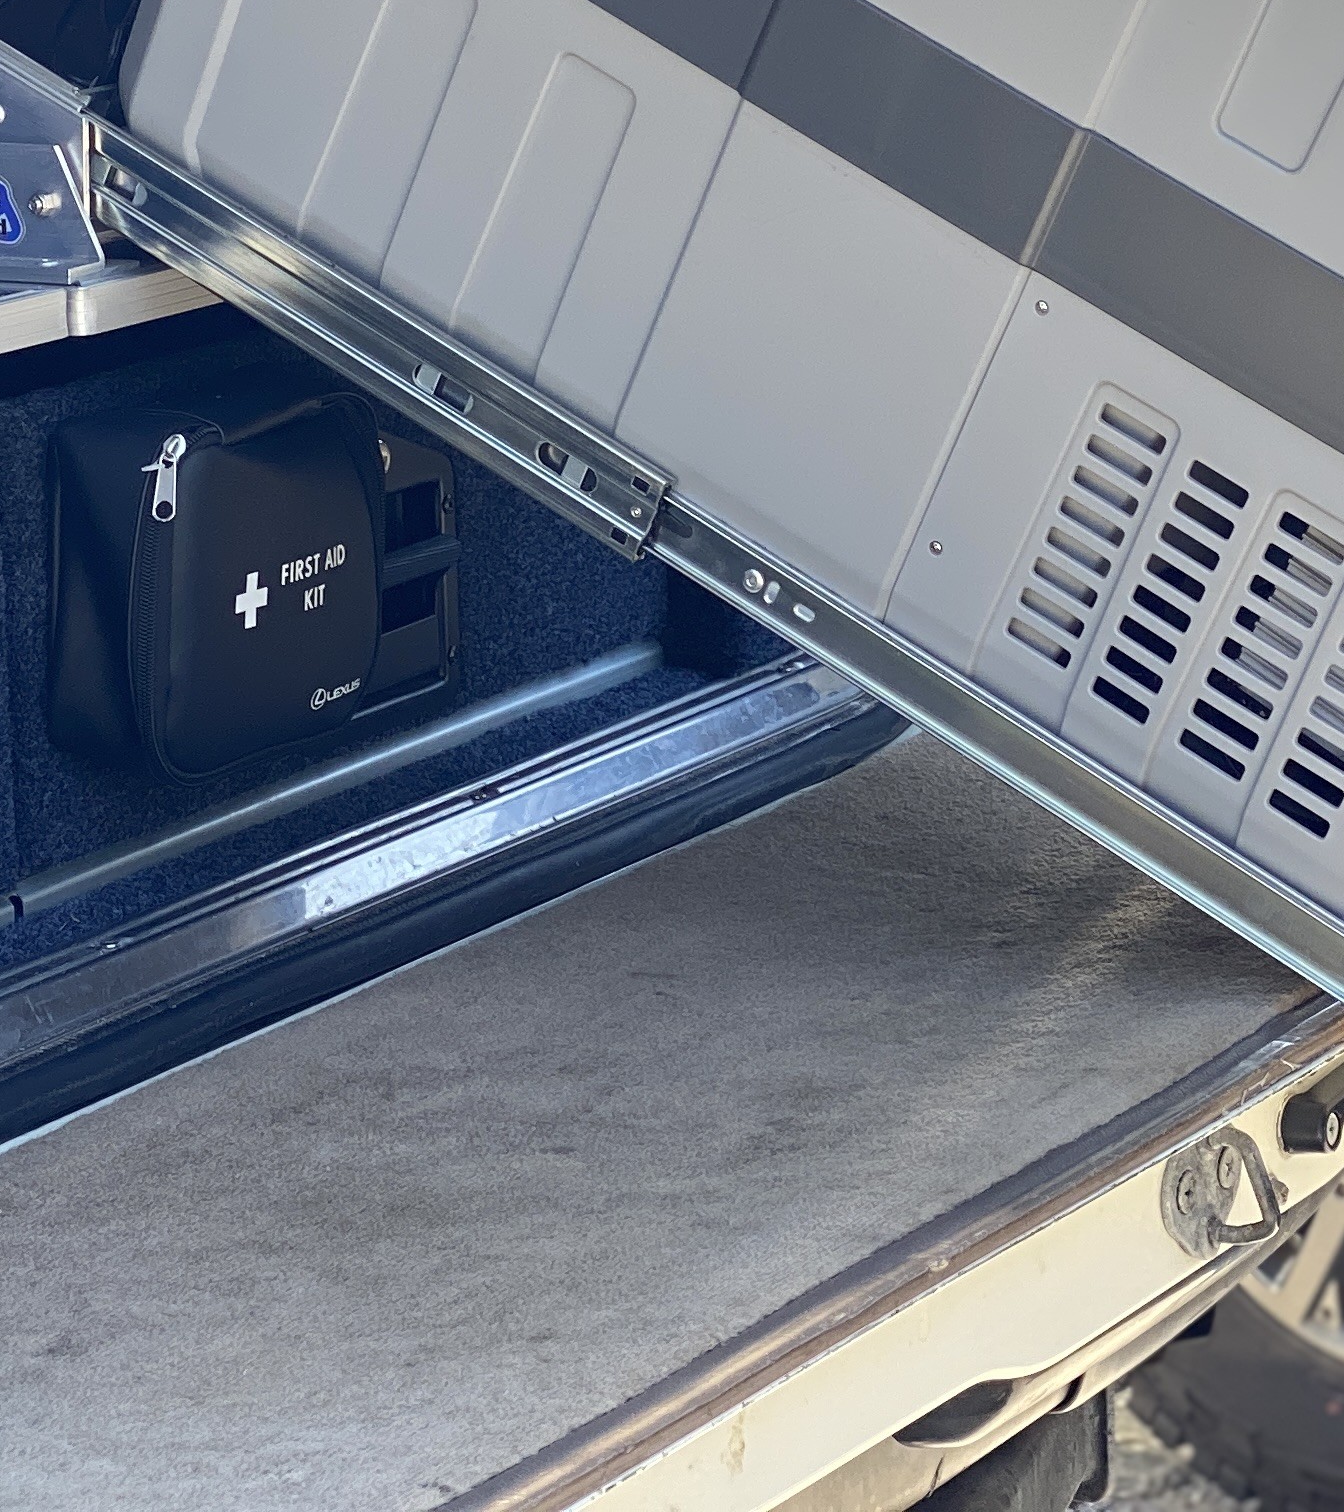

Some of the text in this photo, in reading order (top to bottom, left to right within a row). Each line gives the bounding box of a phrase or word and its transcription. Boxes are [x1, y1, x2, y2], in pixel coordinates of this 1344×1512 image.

[281, 544, 346, 586] FIRST AID
[304, 584, 326, 611] KIT
[326, 678, 361, 701] LEXUS
